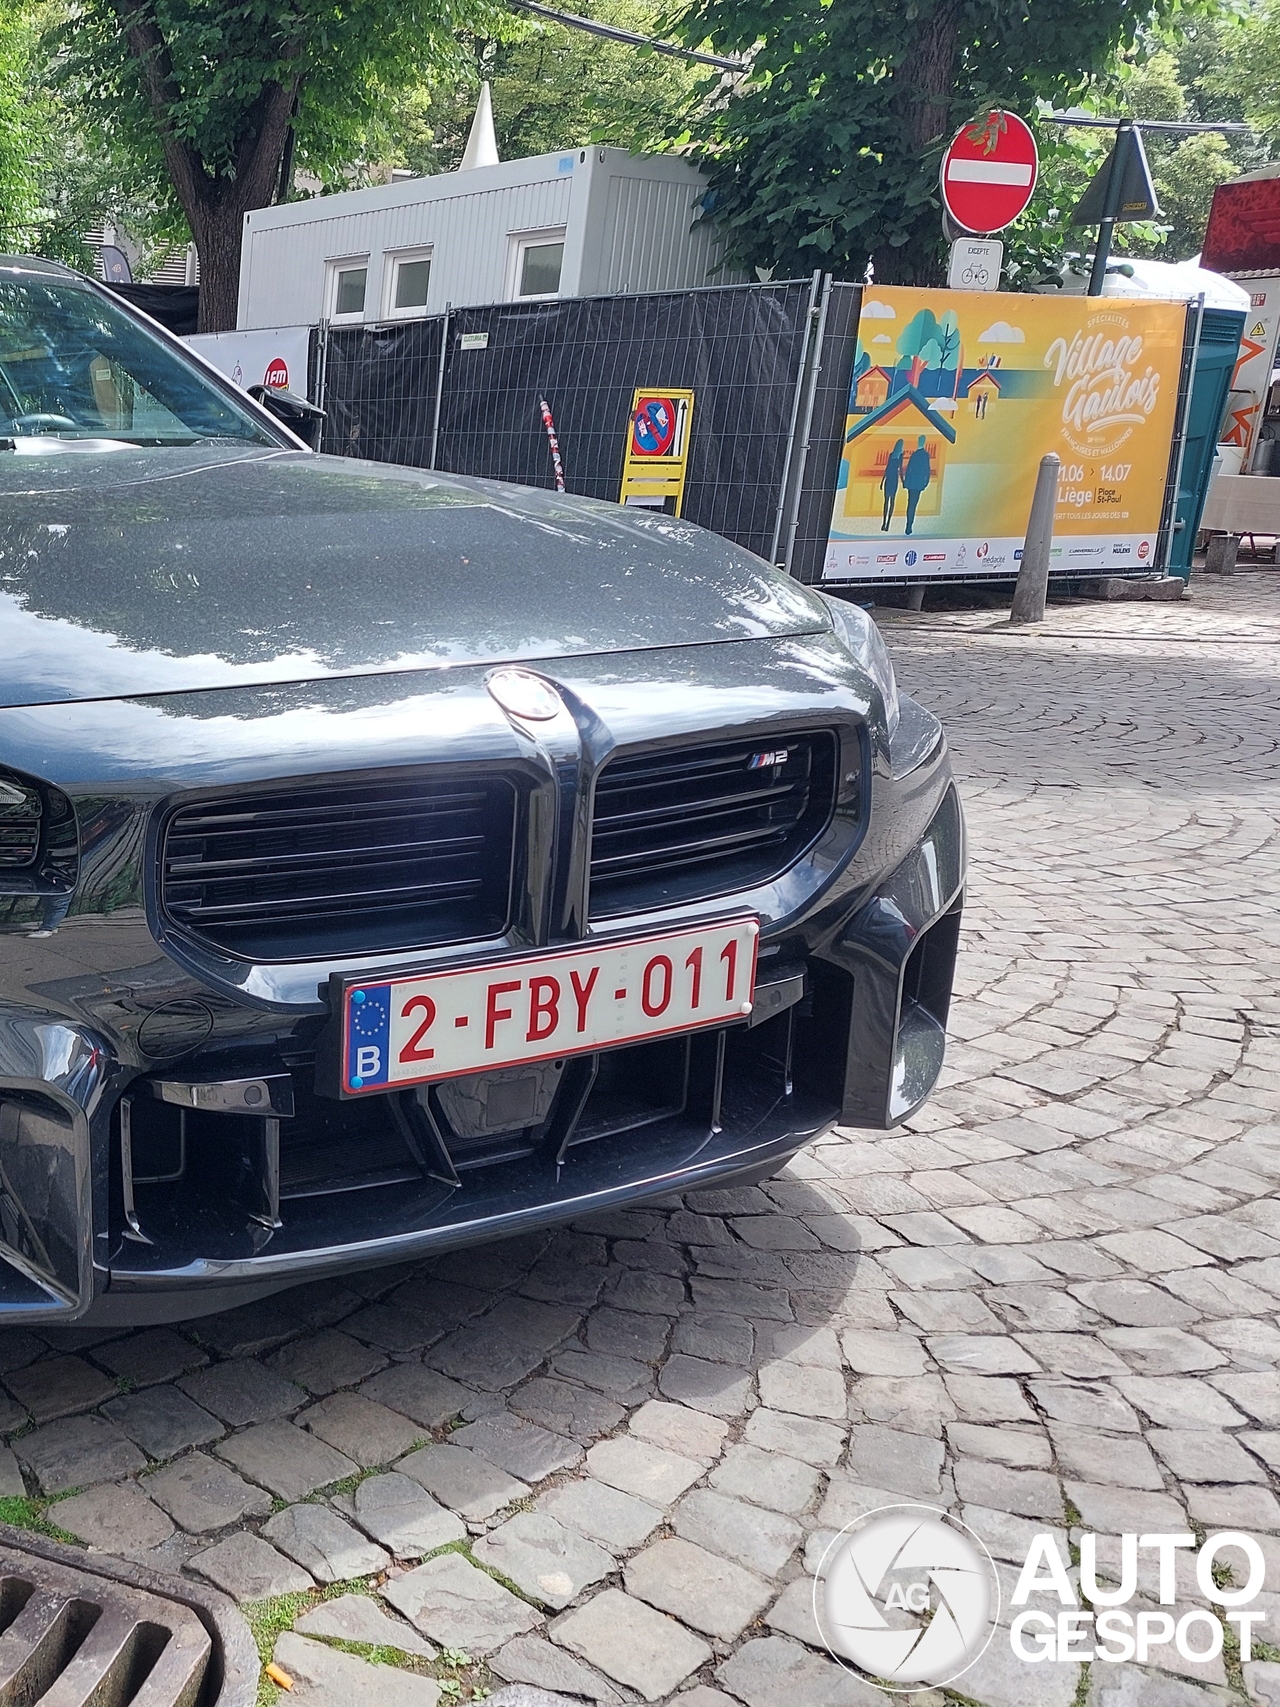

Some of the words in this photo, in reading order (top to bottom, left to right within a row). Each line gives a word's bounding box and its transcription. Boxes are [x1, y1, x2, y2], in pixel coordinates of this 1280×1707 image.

[967, 246, 990, 256] EXCEPTE
[1044, 329, 1143, 386] Village
[1062, 366, 1161, 432] Gaulois
[1060, 427, 1092, 457] FRANÇAISES
[1092, 448, 1100, 457] ET
[1100, 426, 1134, 454] WALLONNES
[1100, 463, 1132, 482] 14.07
[1057, 486, 1093, 508] Liège
[1097, 495, 1122, 504] St-Paul
[1098, 487, 1116, 496] Place
[1067, 512, 1081, 520] TOUS
[1081, 512, 1091, 520] LES
[1091, 511, 1109, 519] JOURS
[758, 750, 788, 767] M2
[398, 939, 738, 1064] 2-FBY-011
[357, 1046, 381, 1079] B
